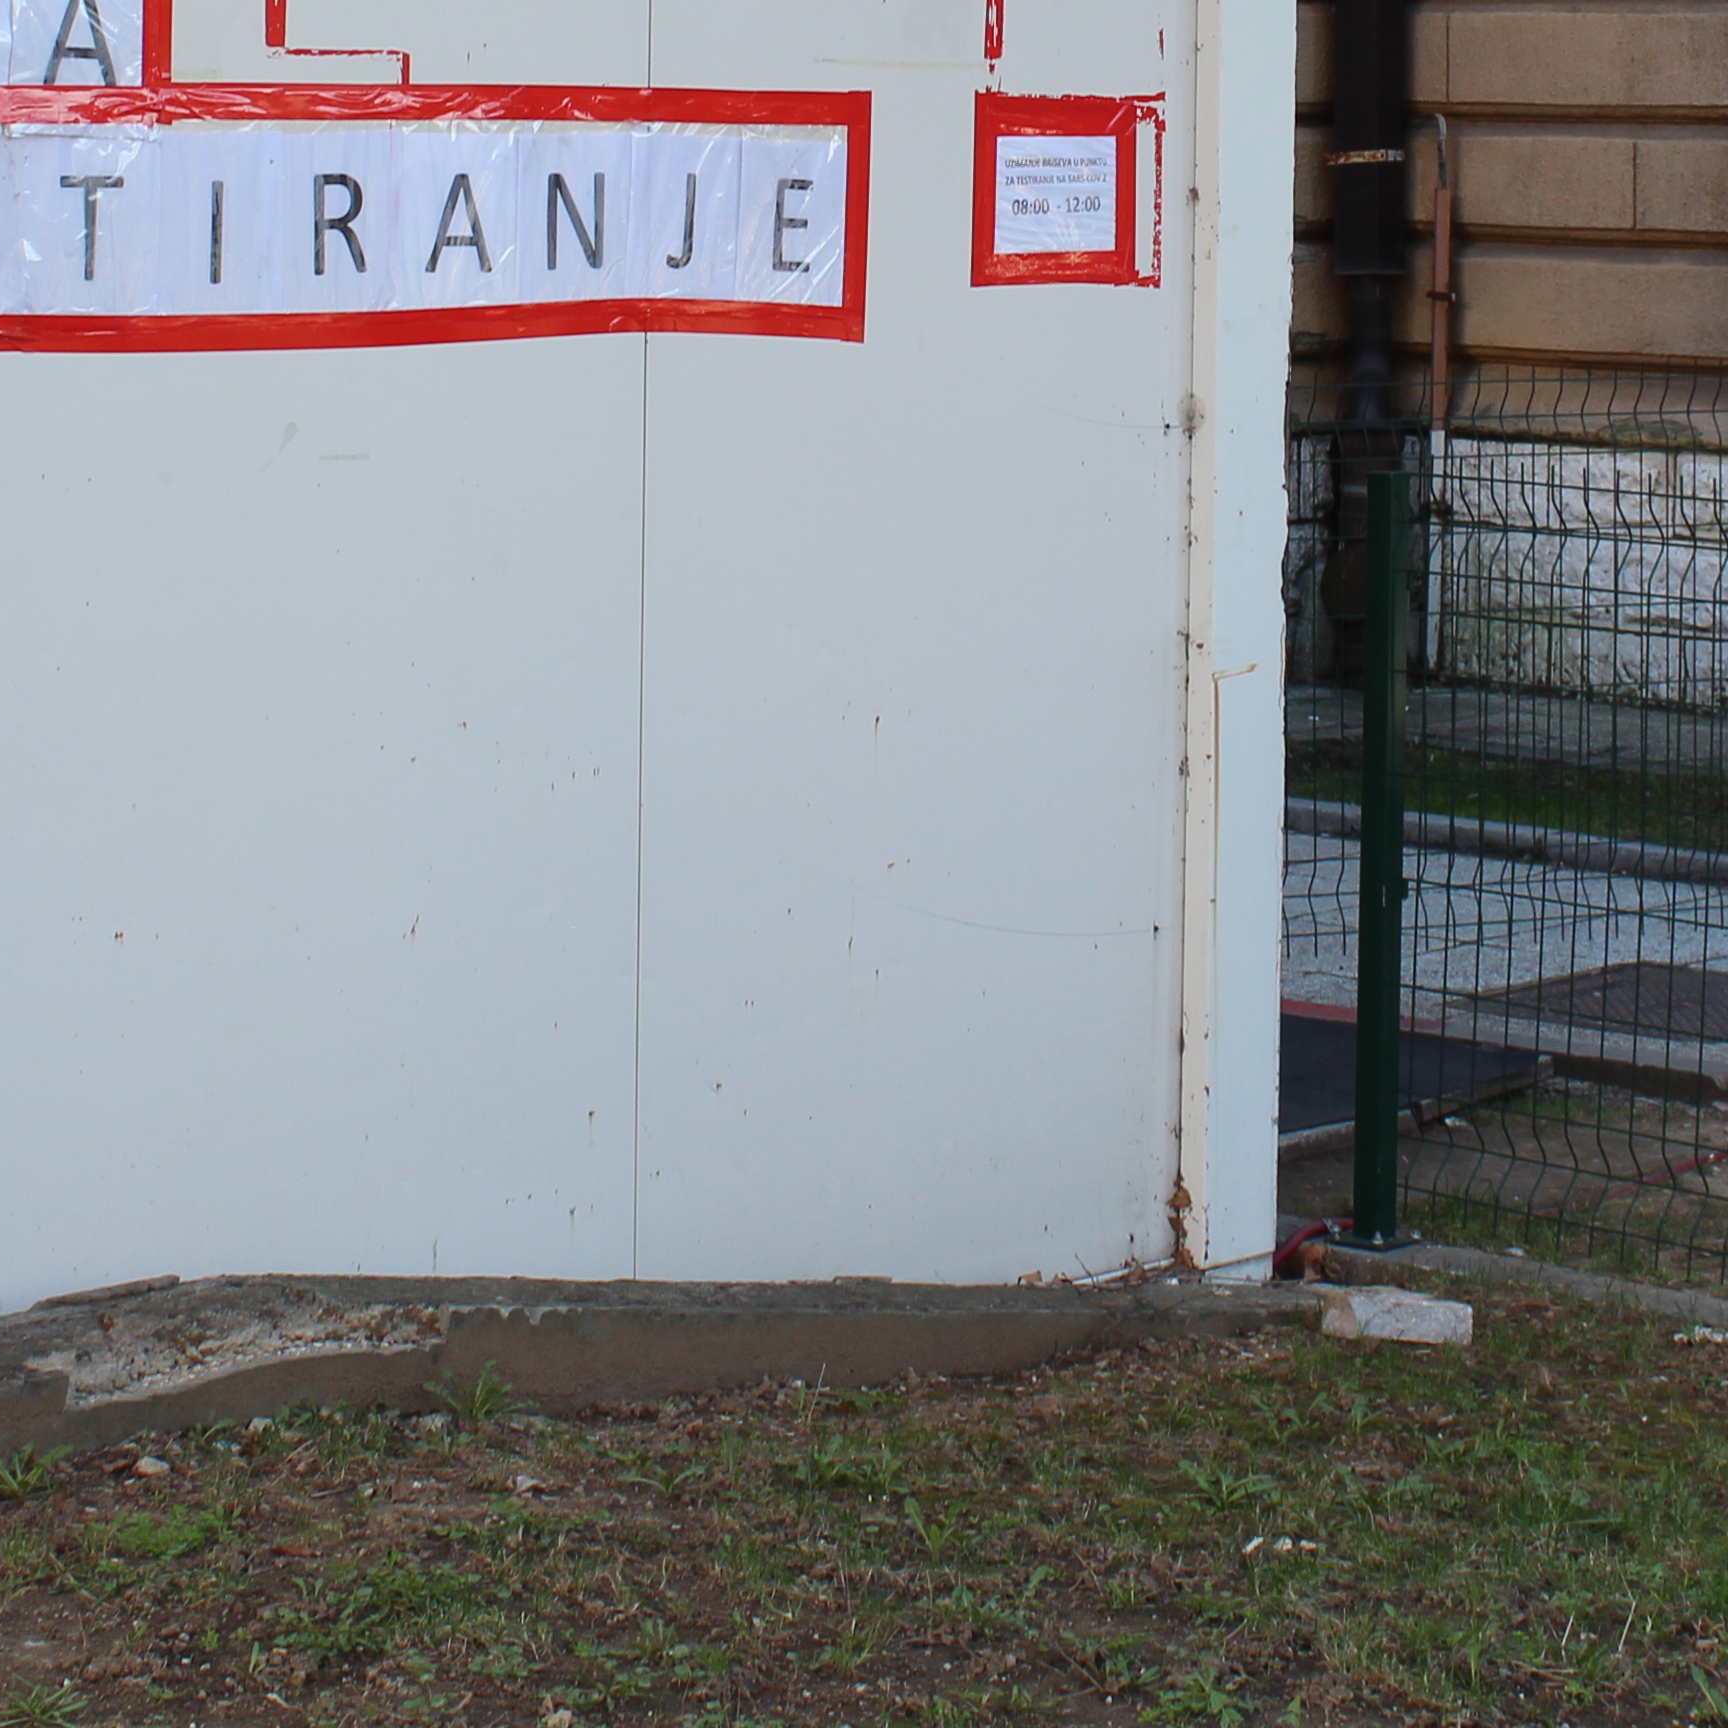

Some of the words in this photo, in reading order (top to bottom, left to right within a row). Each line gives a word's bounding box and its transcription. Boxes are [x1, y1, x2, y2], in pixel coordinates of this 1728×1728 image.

[1073, 158, 1079, 167] U
[1005, 176, 1015, 186] ZA
[1056, 175, 1066, 184] NA
[1011, 198, 1050, 216] 08:00
[1065, 196, 1101, 213] 12:00
